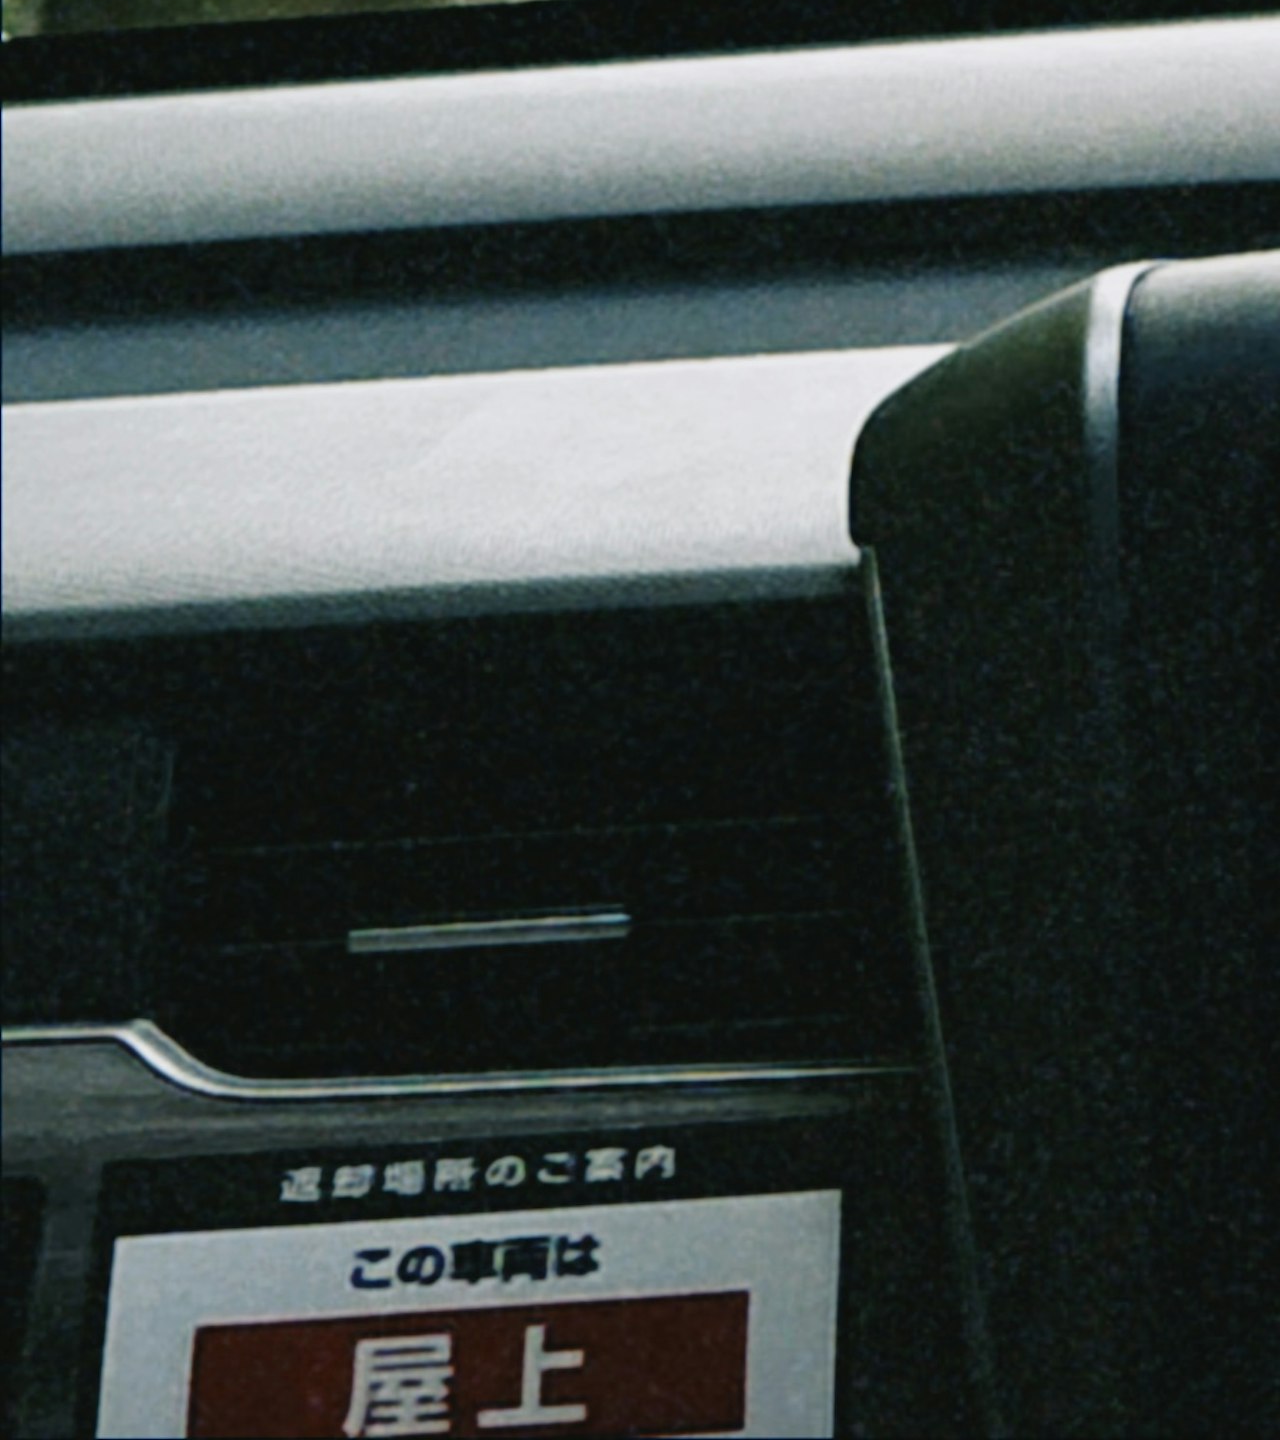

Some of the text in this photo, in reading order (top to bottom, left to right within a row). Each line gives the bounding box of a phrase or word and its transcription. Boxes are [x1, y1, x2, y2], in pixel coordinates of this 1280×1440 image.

[350, 1233, 601, 1290] この車両は
[342, 1324, 588, 1438] 屋上
